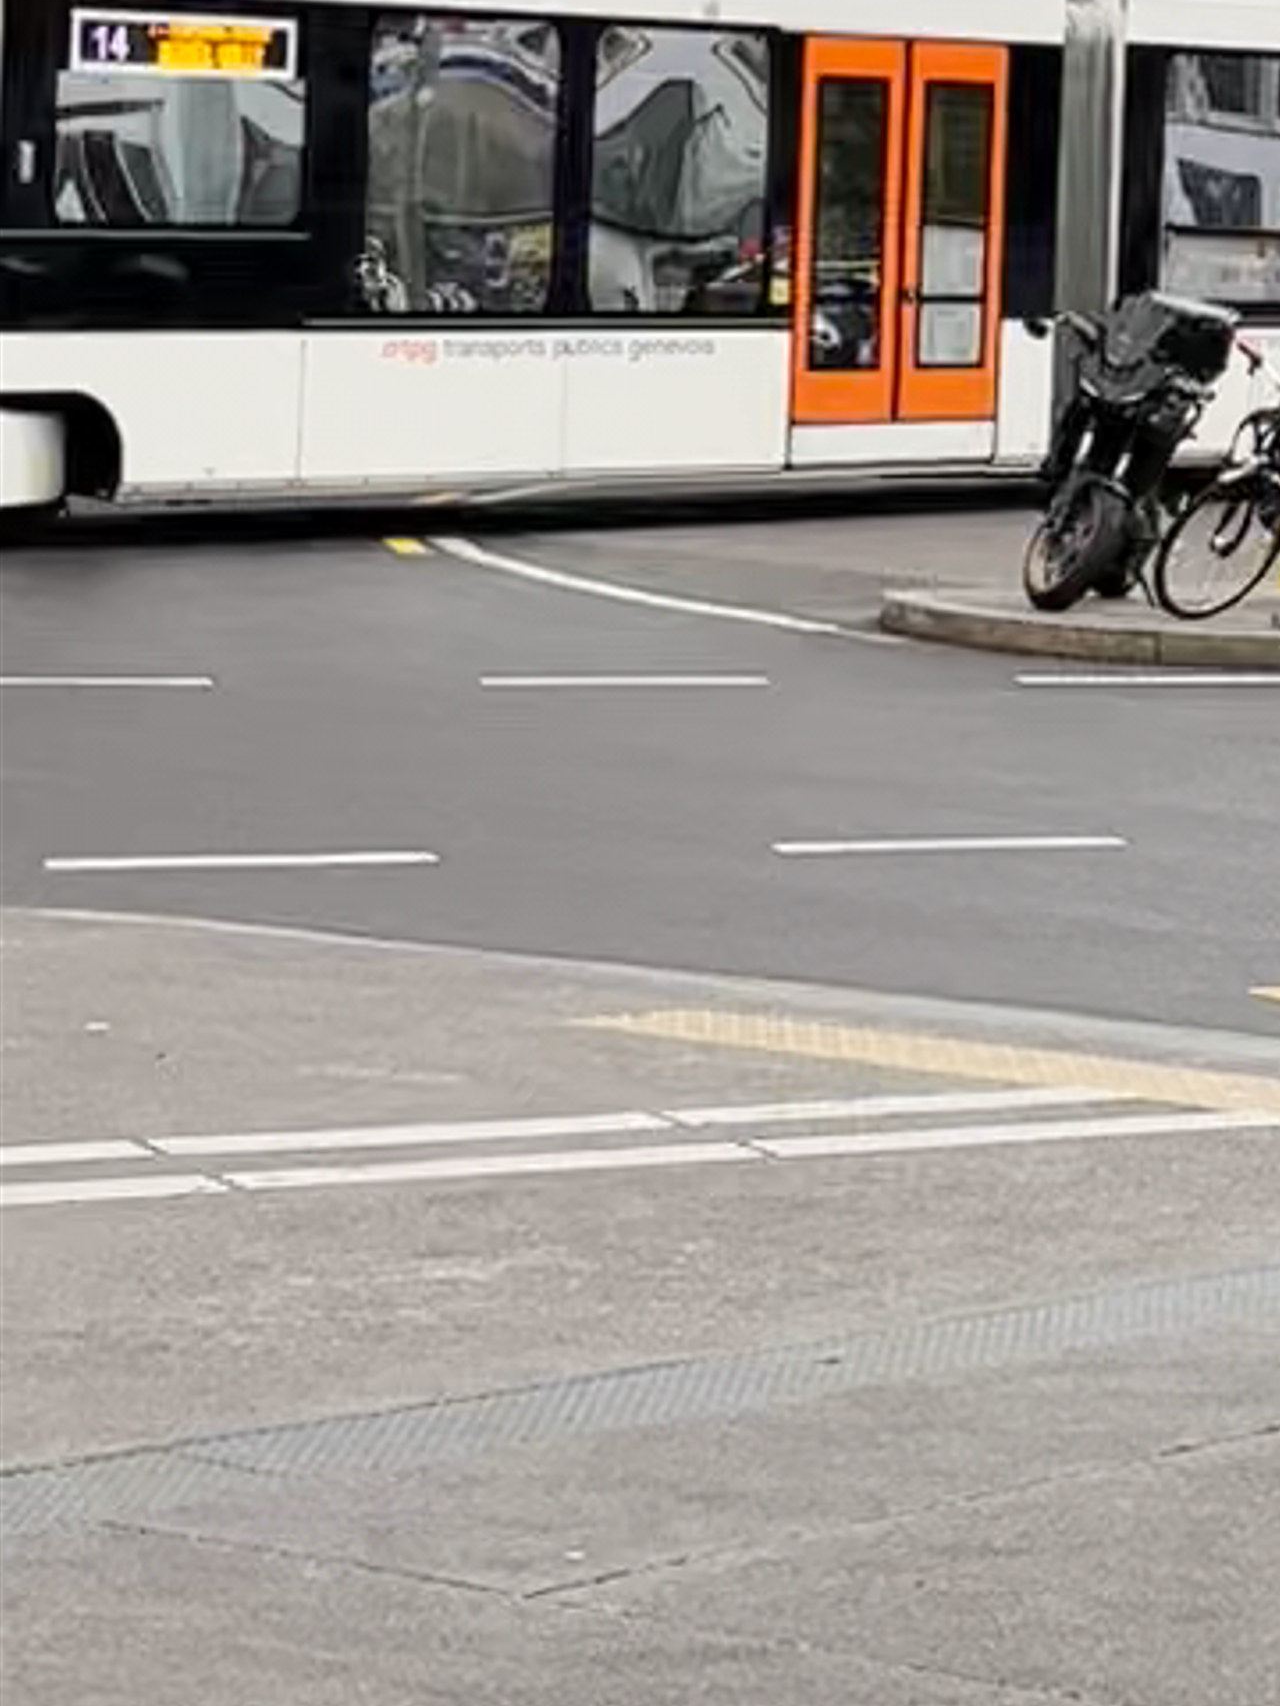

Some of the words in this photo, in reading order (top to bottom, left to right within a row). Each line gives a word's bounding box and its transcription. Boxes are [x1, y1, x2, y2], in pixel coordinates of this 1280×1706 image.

[91, 24, 130, 63] 14
[442, 339, 547, 360] transports
[551, 339, 623, 360] publics
[627, 341, 715, 362] genevois
